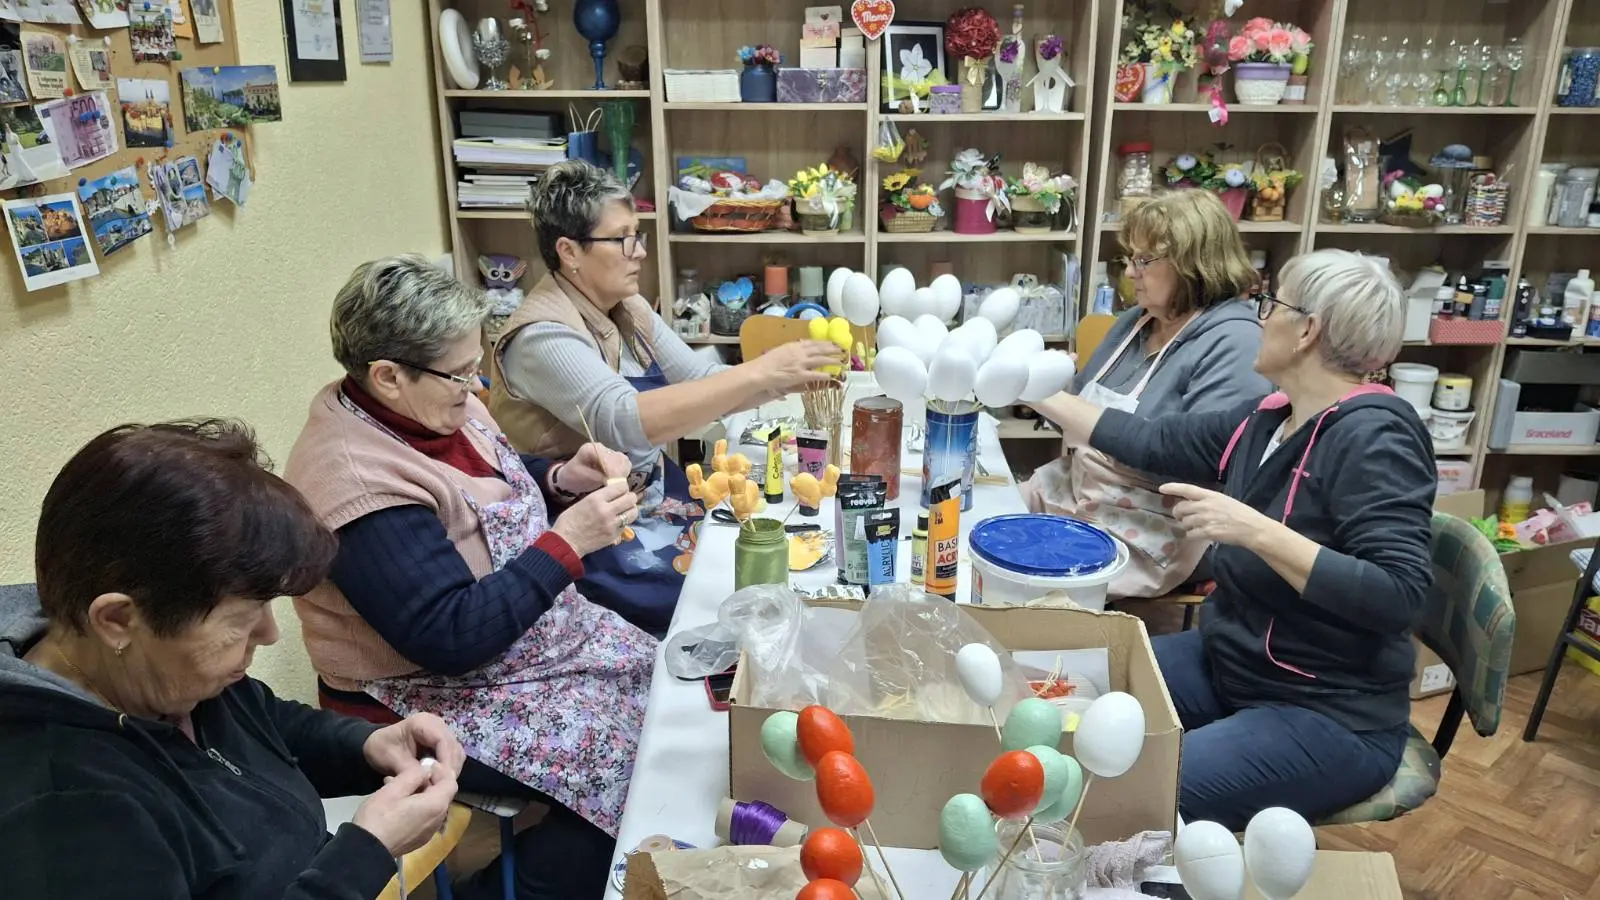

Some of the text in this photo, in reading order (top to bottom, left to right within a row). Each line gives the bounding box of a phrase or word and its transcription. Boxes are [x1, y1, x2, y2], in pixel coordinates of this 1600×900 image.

[861, 11, 888, 23] Mama
[1526, 429, 1573, 438] Graceland
[850, 498, 877, 507] reeves
[938, 537, 958, 552] BASI
[880, 541, 891, 577] ACRYLIC
